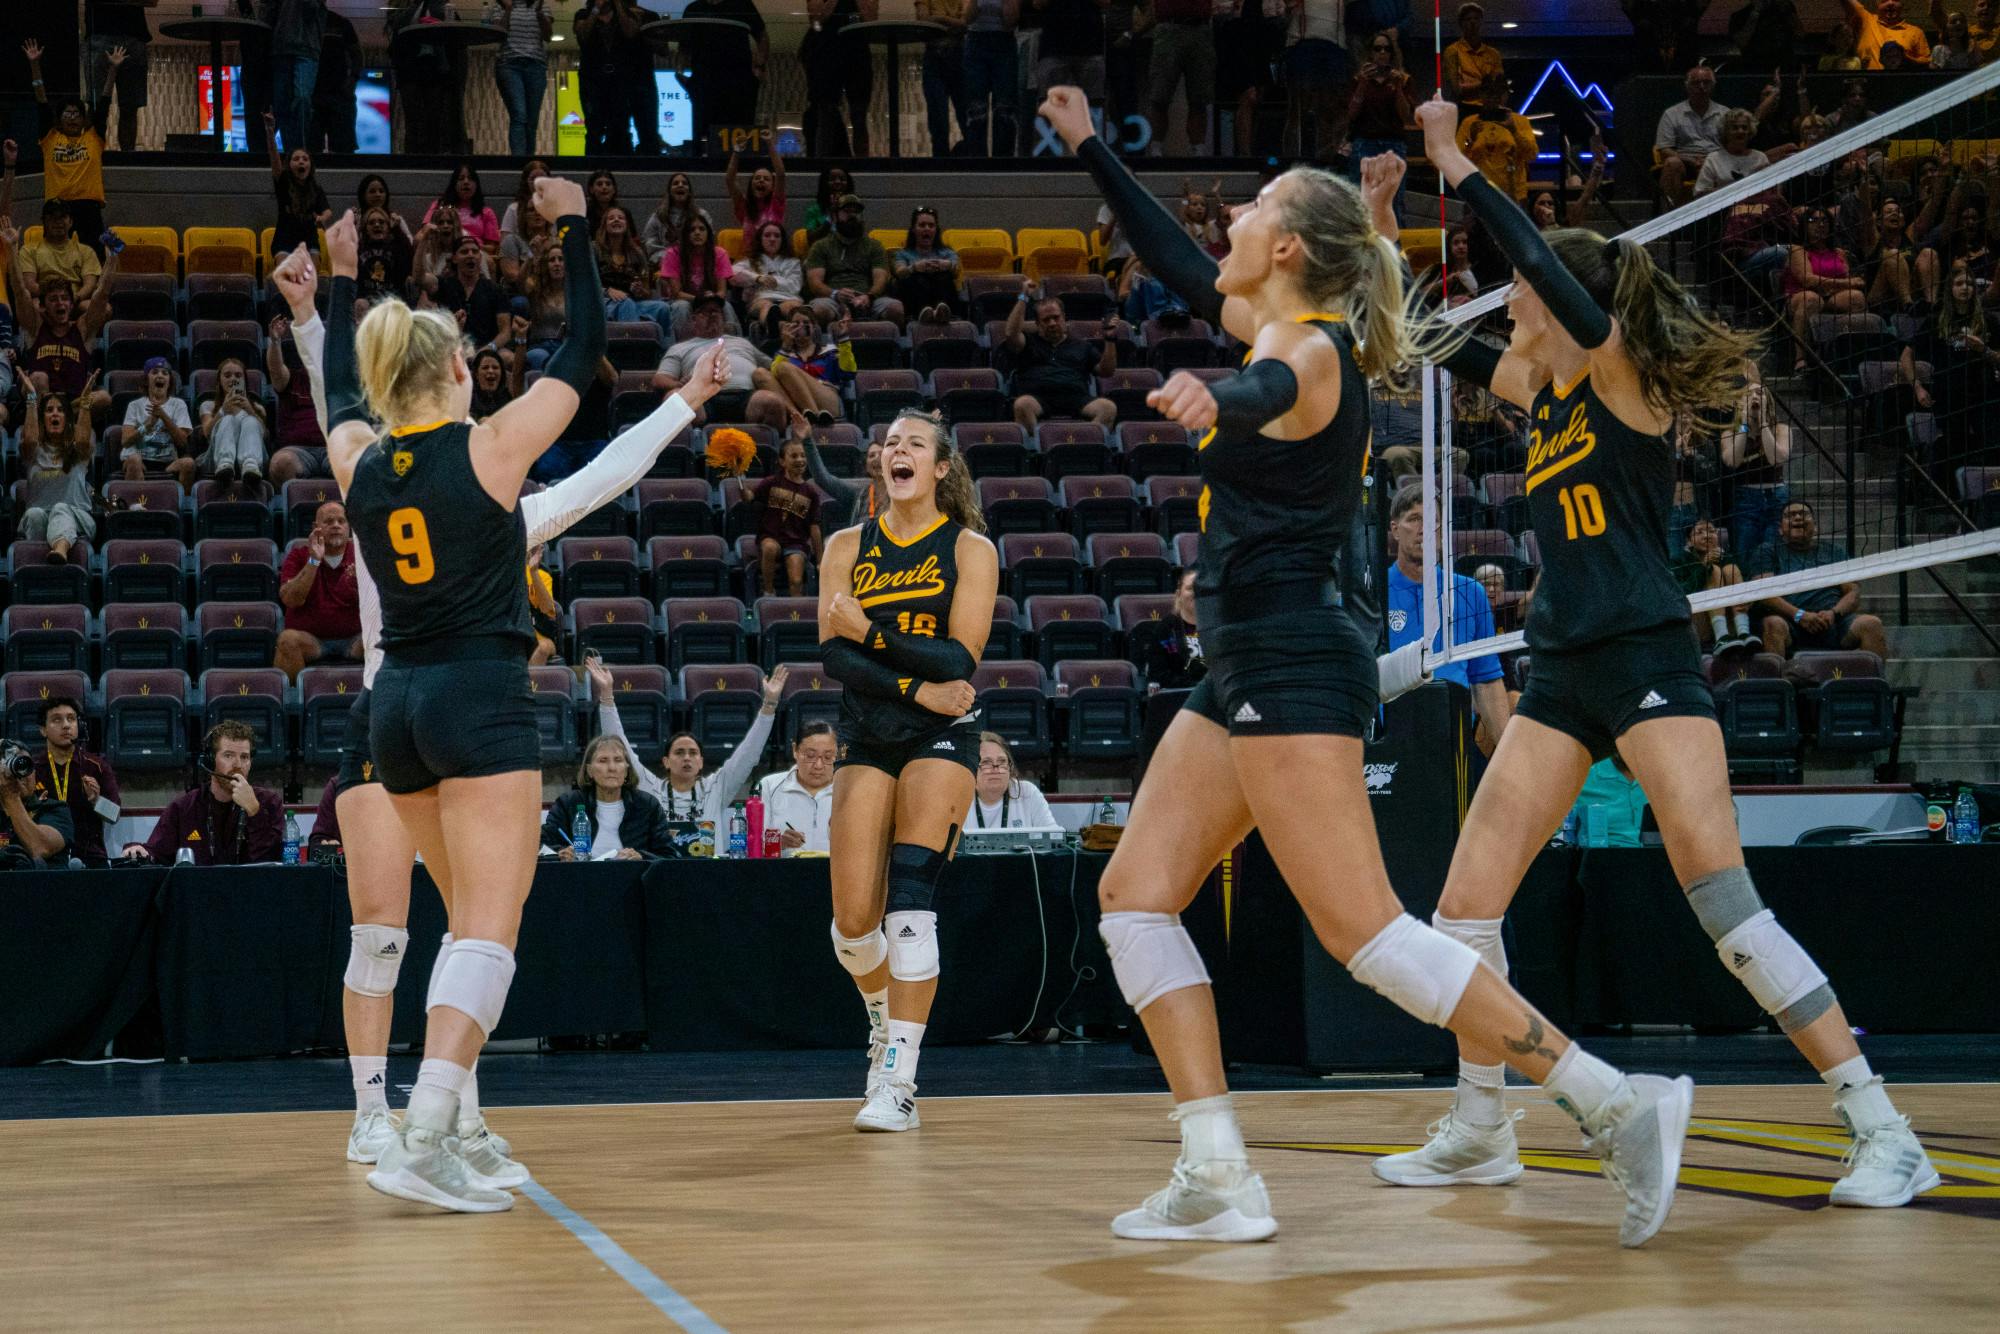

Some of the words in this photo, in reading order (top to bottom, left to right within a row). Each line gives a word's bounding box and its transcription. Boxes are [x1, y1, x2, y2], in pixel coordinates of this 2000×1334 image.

[661, 92, 681, 100] THE
[1526, 401, 1596, 480] Devils
[1558, 484, 1607, 540] 10
[387, 507, 436, 585] 9
[853, 555, 943, 600] Devils
